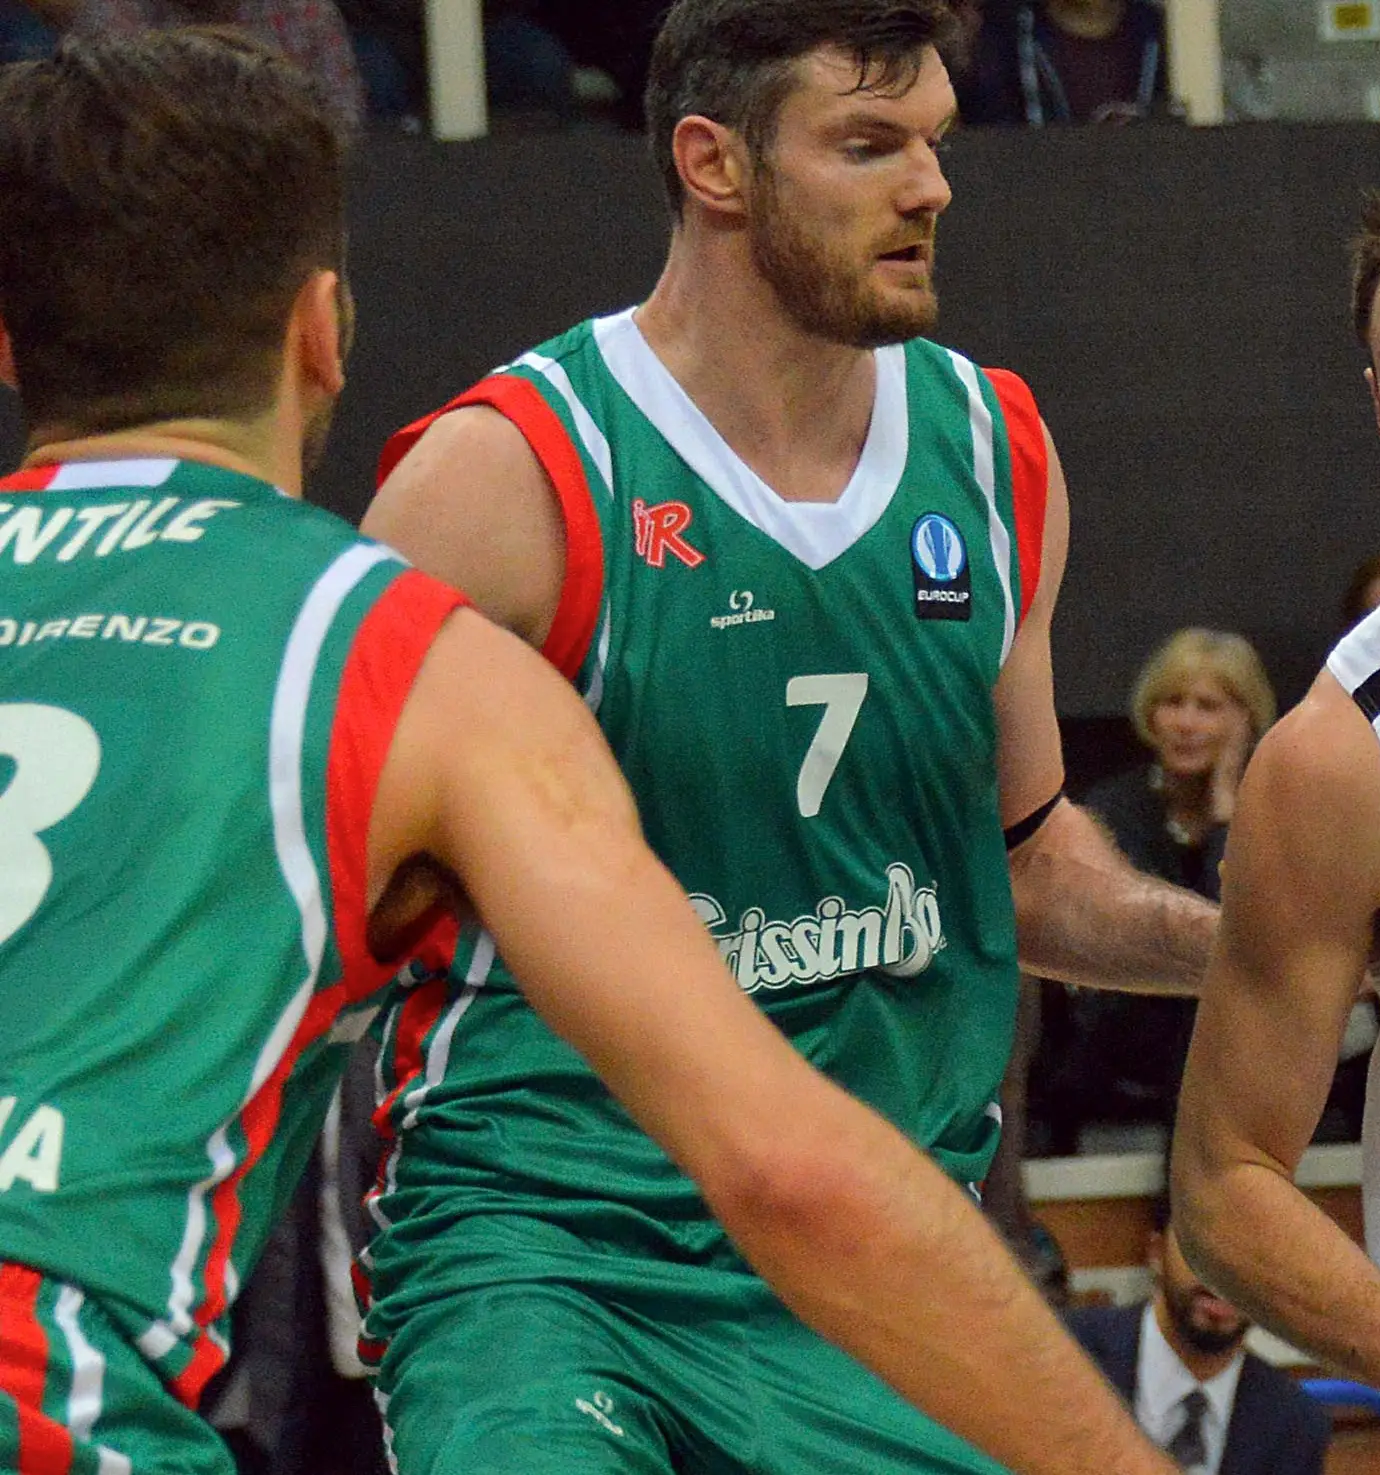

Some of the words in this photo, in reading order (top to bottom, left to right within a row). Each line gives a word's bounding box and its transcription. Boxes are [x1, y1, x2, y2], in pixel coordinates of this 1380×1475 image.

[0, 496, 243, 564] NTILE
[917, 589, 969, 603] EUROCUP
[711, 609, 775, 630] sportika
[786, 672, 869, 818] 7
